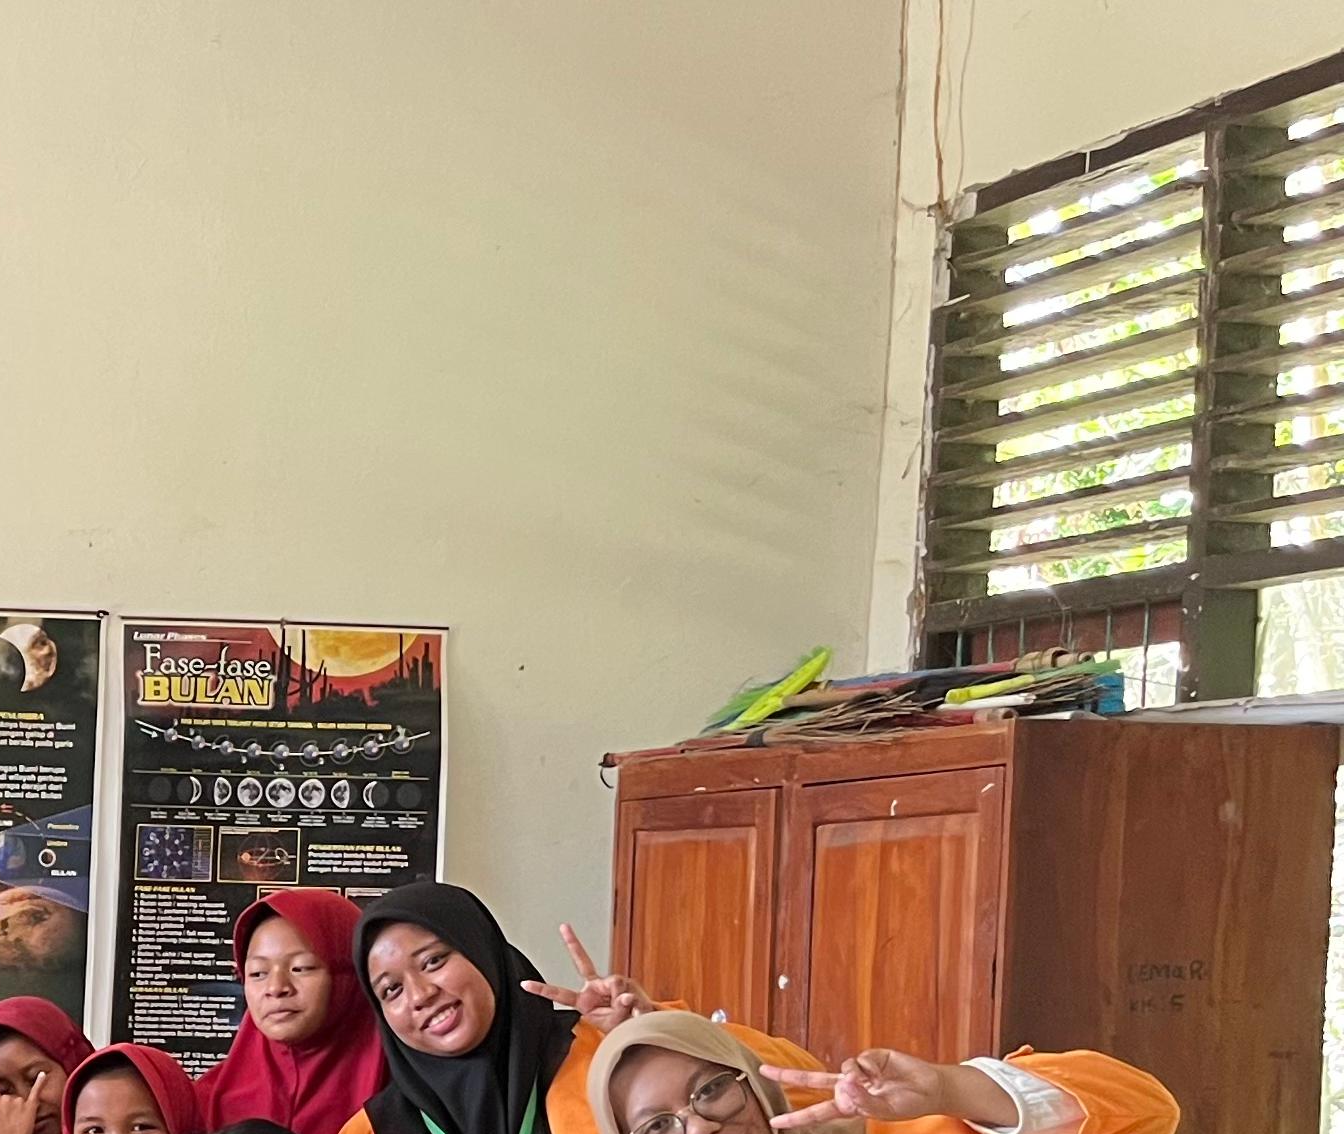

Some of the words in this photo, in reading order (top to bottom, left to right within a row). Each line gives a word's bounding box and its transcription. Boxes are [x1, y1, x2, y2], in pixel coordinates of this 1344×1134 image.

[133, 631, 165, 640] Lunar
[143, 643, 271, 677] Fase-fase
[141, 675, 272, 706] BULAN
